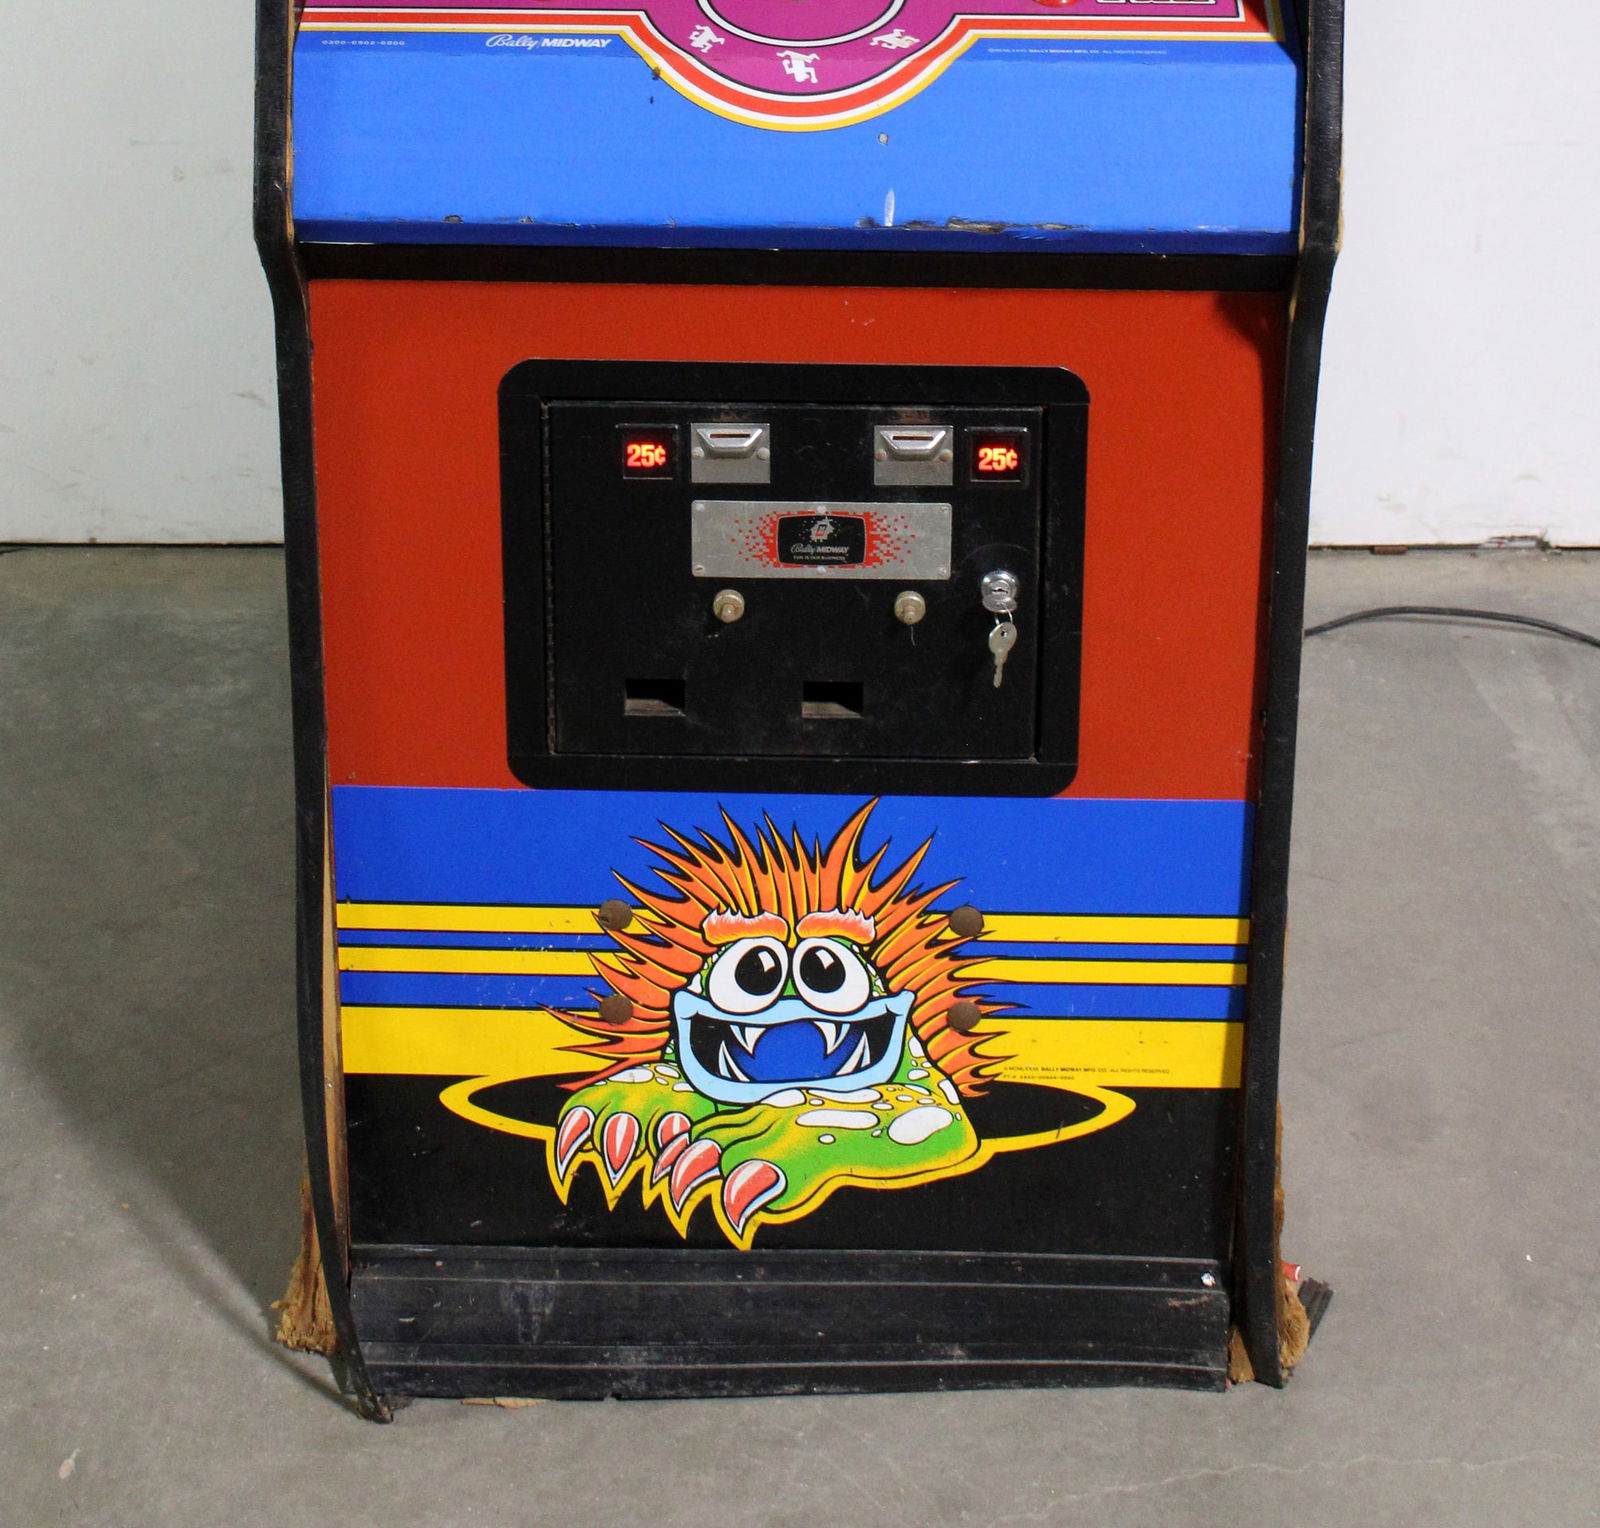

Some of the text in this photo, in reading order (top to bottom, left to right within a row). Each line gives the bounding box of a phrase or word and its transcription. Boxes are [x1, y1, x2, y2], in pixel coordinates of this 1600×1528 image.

[485, 34, 612, 50] Bally MIDWAY
[627, 444, 666, 468] 25¢
[979, 447, 1018, 471] 25¢
[816, 545, 849, 554] MIDWAY
